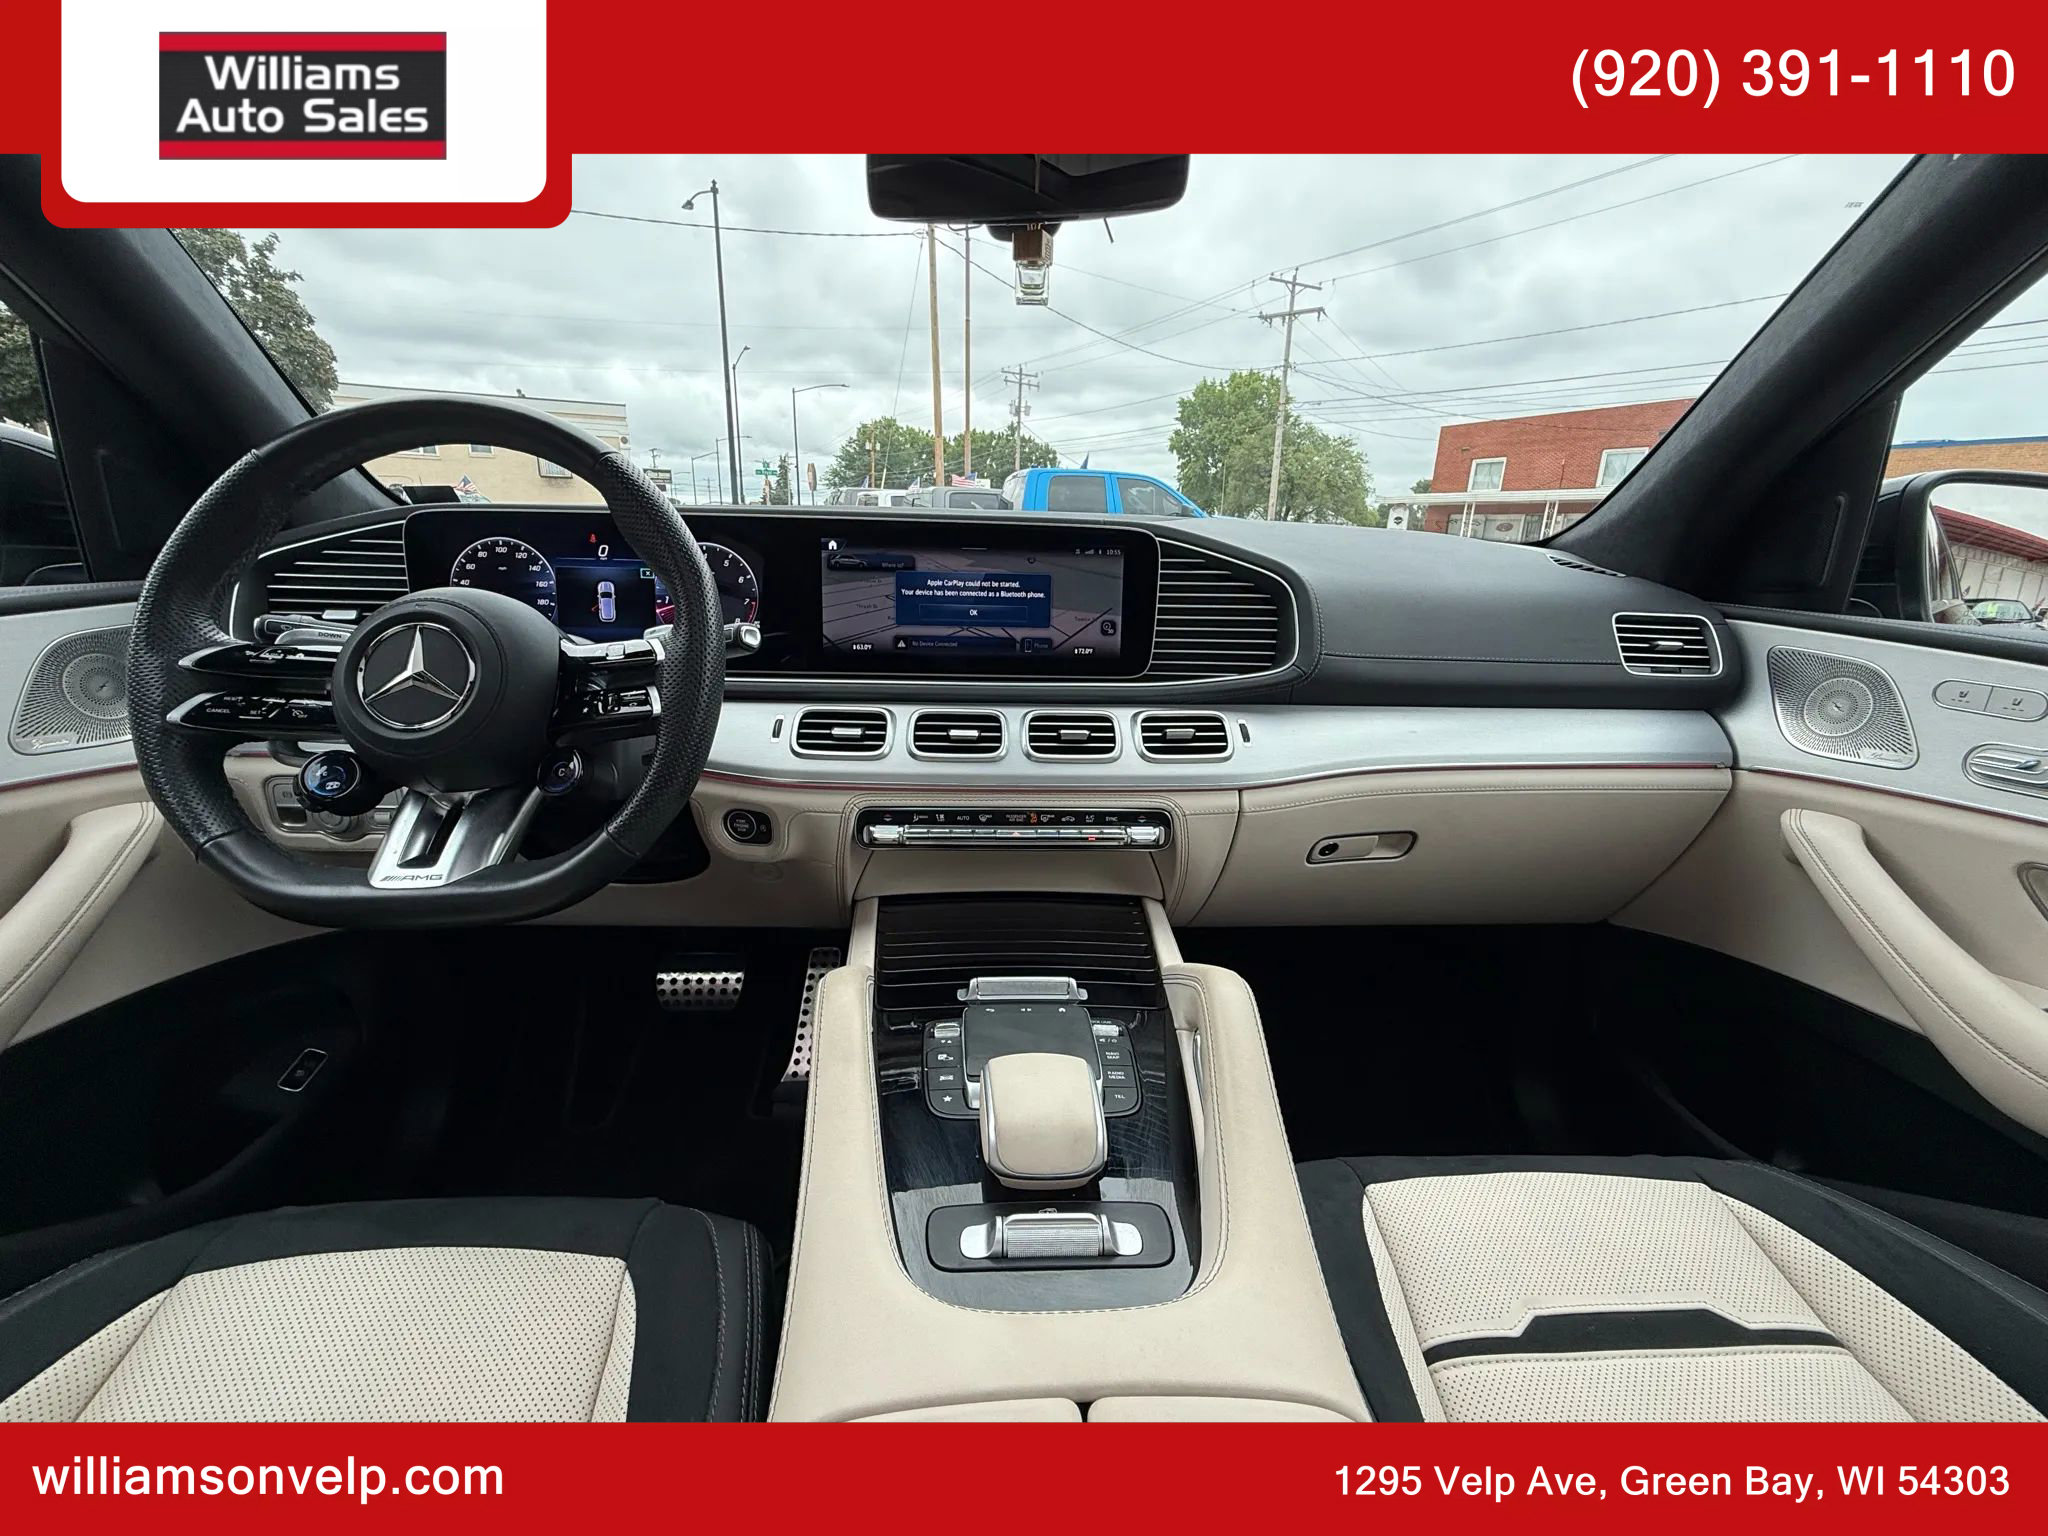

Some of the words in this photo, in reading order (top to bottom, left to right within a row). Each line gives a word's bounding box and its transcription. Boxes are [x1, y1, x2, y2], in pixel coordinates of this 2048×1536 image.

[927, 579, 943, 587] Apple
[944, 579, 964, 588] CarPlay
[1000, 590, 1026, 598] Bluetooth
[1027, 591, 1045, 599] phone.
